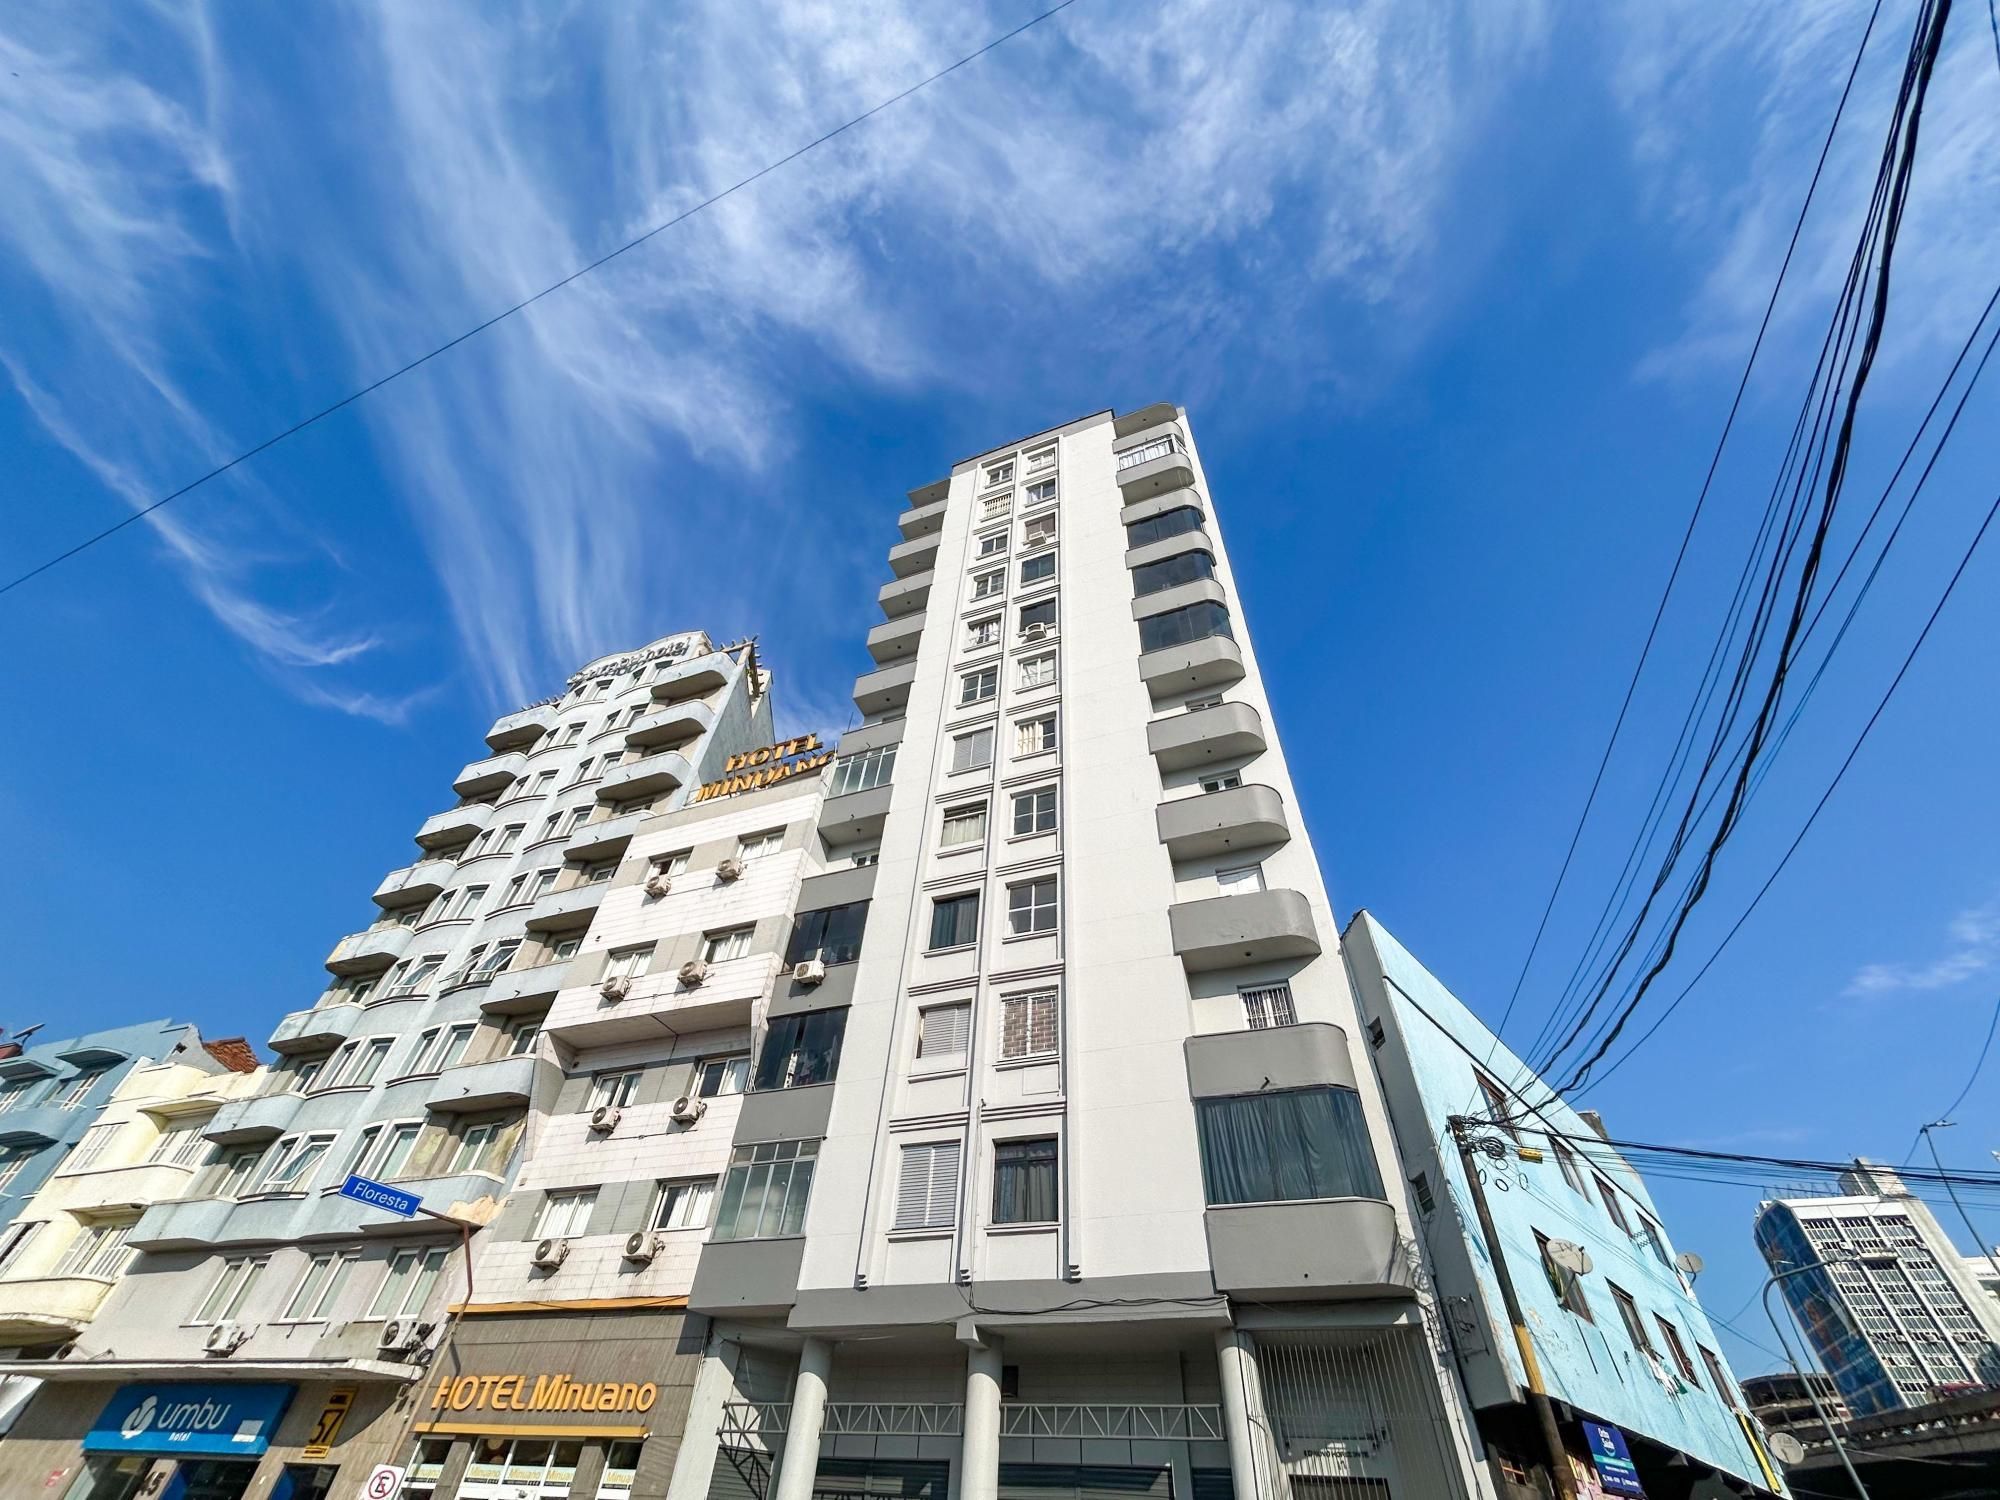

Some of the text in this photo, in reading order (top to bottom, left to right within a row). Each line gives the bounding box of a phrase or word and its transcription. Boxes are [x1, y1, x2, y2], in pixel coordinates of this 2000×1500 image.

[725, 732, 823, 772] HOTEL
[352, 1182, 409, 1211] Floresta
[431, 1374, 657, 1413] HOTEL Minuano
[157, 1396, 231, 1430] umbu
[168, 1431, 192, 1441] hotel
